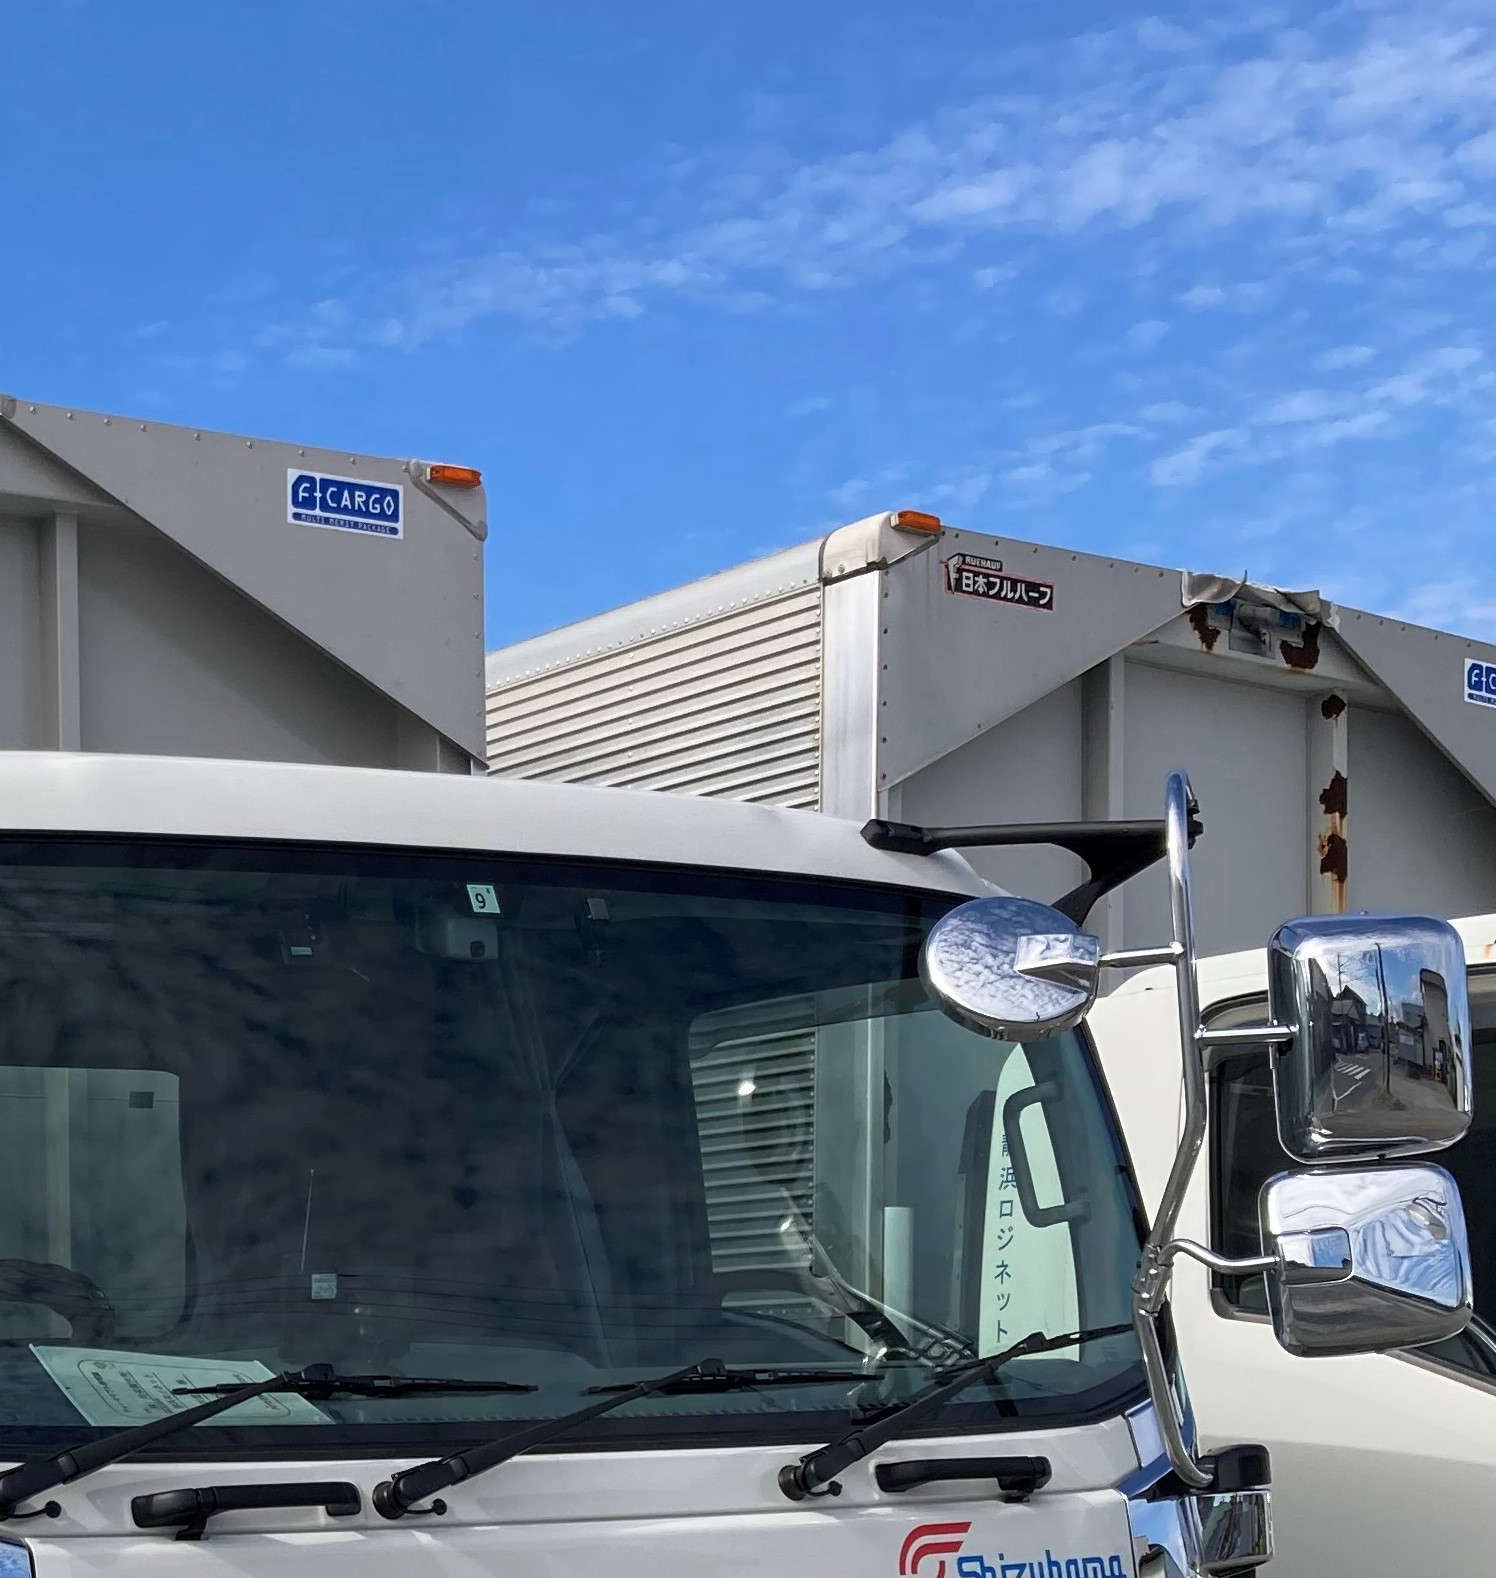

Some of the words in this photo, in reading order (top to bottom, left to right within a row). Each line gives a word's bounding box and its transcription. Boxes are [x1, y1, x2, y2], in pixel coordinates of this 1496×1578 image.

[298, 483, 396, 515] F-CARGO
[962, 571, 1051, 605] 日本フルハーフ
[475, 892, 486, 909] 9
